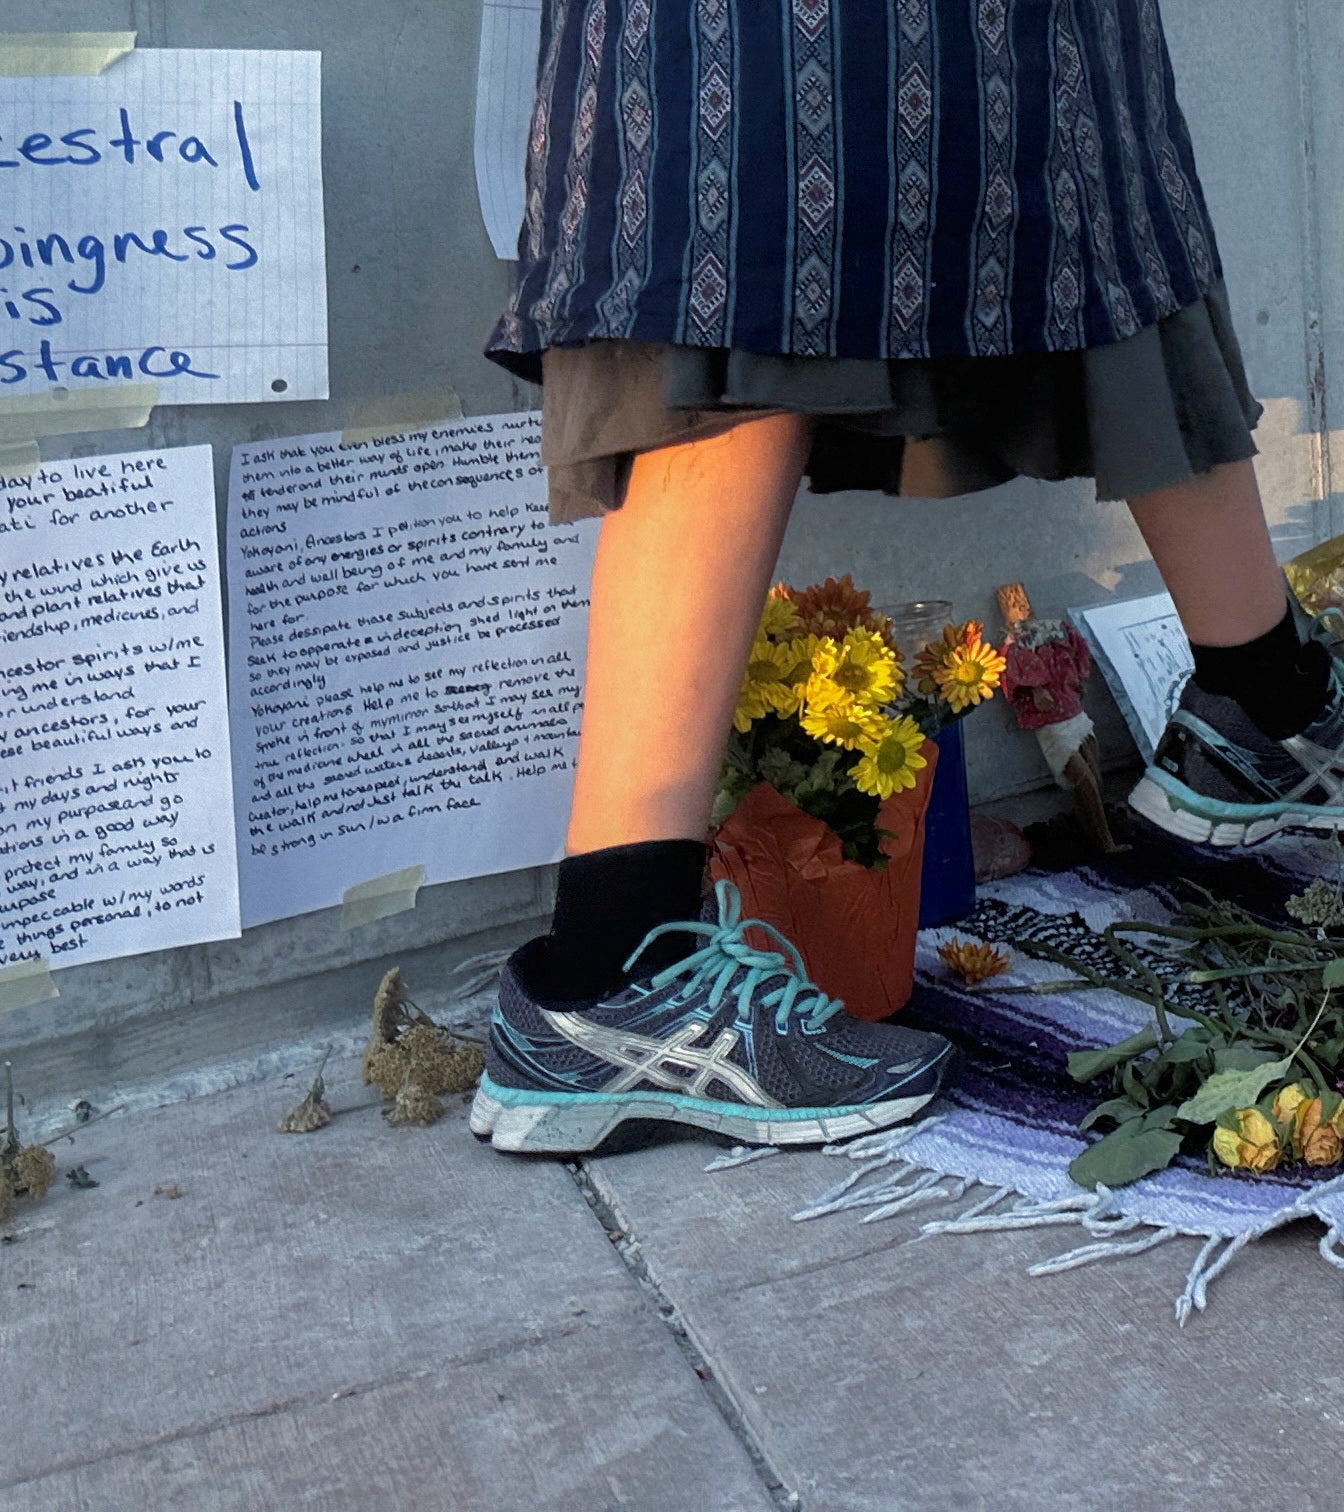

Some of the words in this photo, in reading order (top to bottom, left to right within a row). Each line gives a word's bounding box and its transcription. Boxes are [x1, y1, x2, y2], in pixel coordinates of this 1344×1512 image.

[38, 469, 63, 485] to
[74, 464, 112, 479] live
[121, 457, 168, 475] here
[7, 492, 56, 514] your
[50, 508, 81, 527] for
[89, 500, 175, 522] another
[239, 520, 288, 539] actions
[12, 553, 105, 583] relatives
[111, 548, 144, 567] the
[151, 538, 202, 558] Earth
[4, 587, 37, 604] the
[90, 571, 140, 589] which
[145, 562, 185, 583] give
[186, 559, 208, 573] us
[246, 602, 267, 616] for
[269, 597, 292, 610] the
[293, 583, 350, 607] purpose
[355, 580, 380, 593] for
[383, 571, 427, 589] which
[432, 567, 461, 582] you
[466, 559, 500, 574] have
[535, 555, 559, 568] me
[31, 595, 81, 619] plant
[88, 584, 163, 606] relatives
[167, 574, 207, 595] that
[167, 598, 200, 617] and
[250, 618, 277, 633] here
[32, 680, 58, 693] me
[87, 665, 135, 681] ways
[144, 658, 181, 673] that
[187, 655, 202, 669] I
[22, 686, 136, 715] understand
[125, 704, 157, 719] for
[166, 699, 207, 717] your
[31, 728, 113, 752] beautiful
[116, 722, 163, 738] ways
[170, 716, 200, 732] and
[92, 763, 107, 776] I
[151, 753, 195, 771] you
[194, 747, 213, 760] to
[14, 796, 38, 812] my
[41, 789, 82, 806] days
[84, 778, 118, 795] and
[26, 816, 52, 832] my
[160, 794, 185, 812] go
[94, 817, 136, 841] good
[142, 811, 180, 830] way
[49, 867, 79, 884] and
[127, 854, 163, 869] way
[168, 844, 197, 860] that
[201, 842, 216, 856] is
[68, 851, 95, 866] my
[98, 839, 157, 859] family
[160, 836, 180, 848] so
[154, 900, 173, 914] to
[175, 890, 206, 908] not
[50, 933, 90, 956] best
